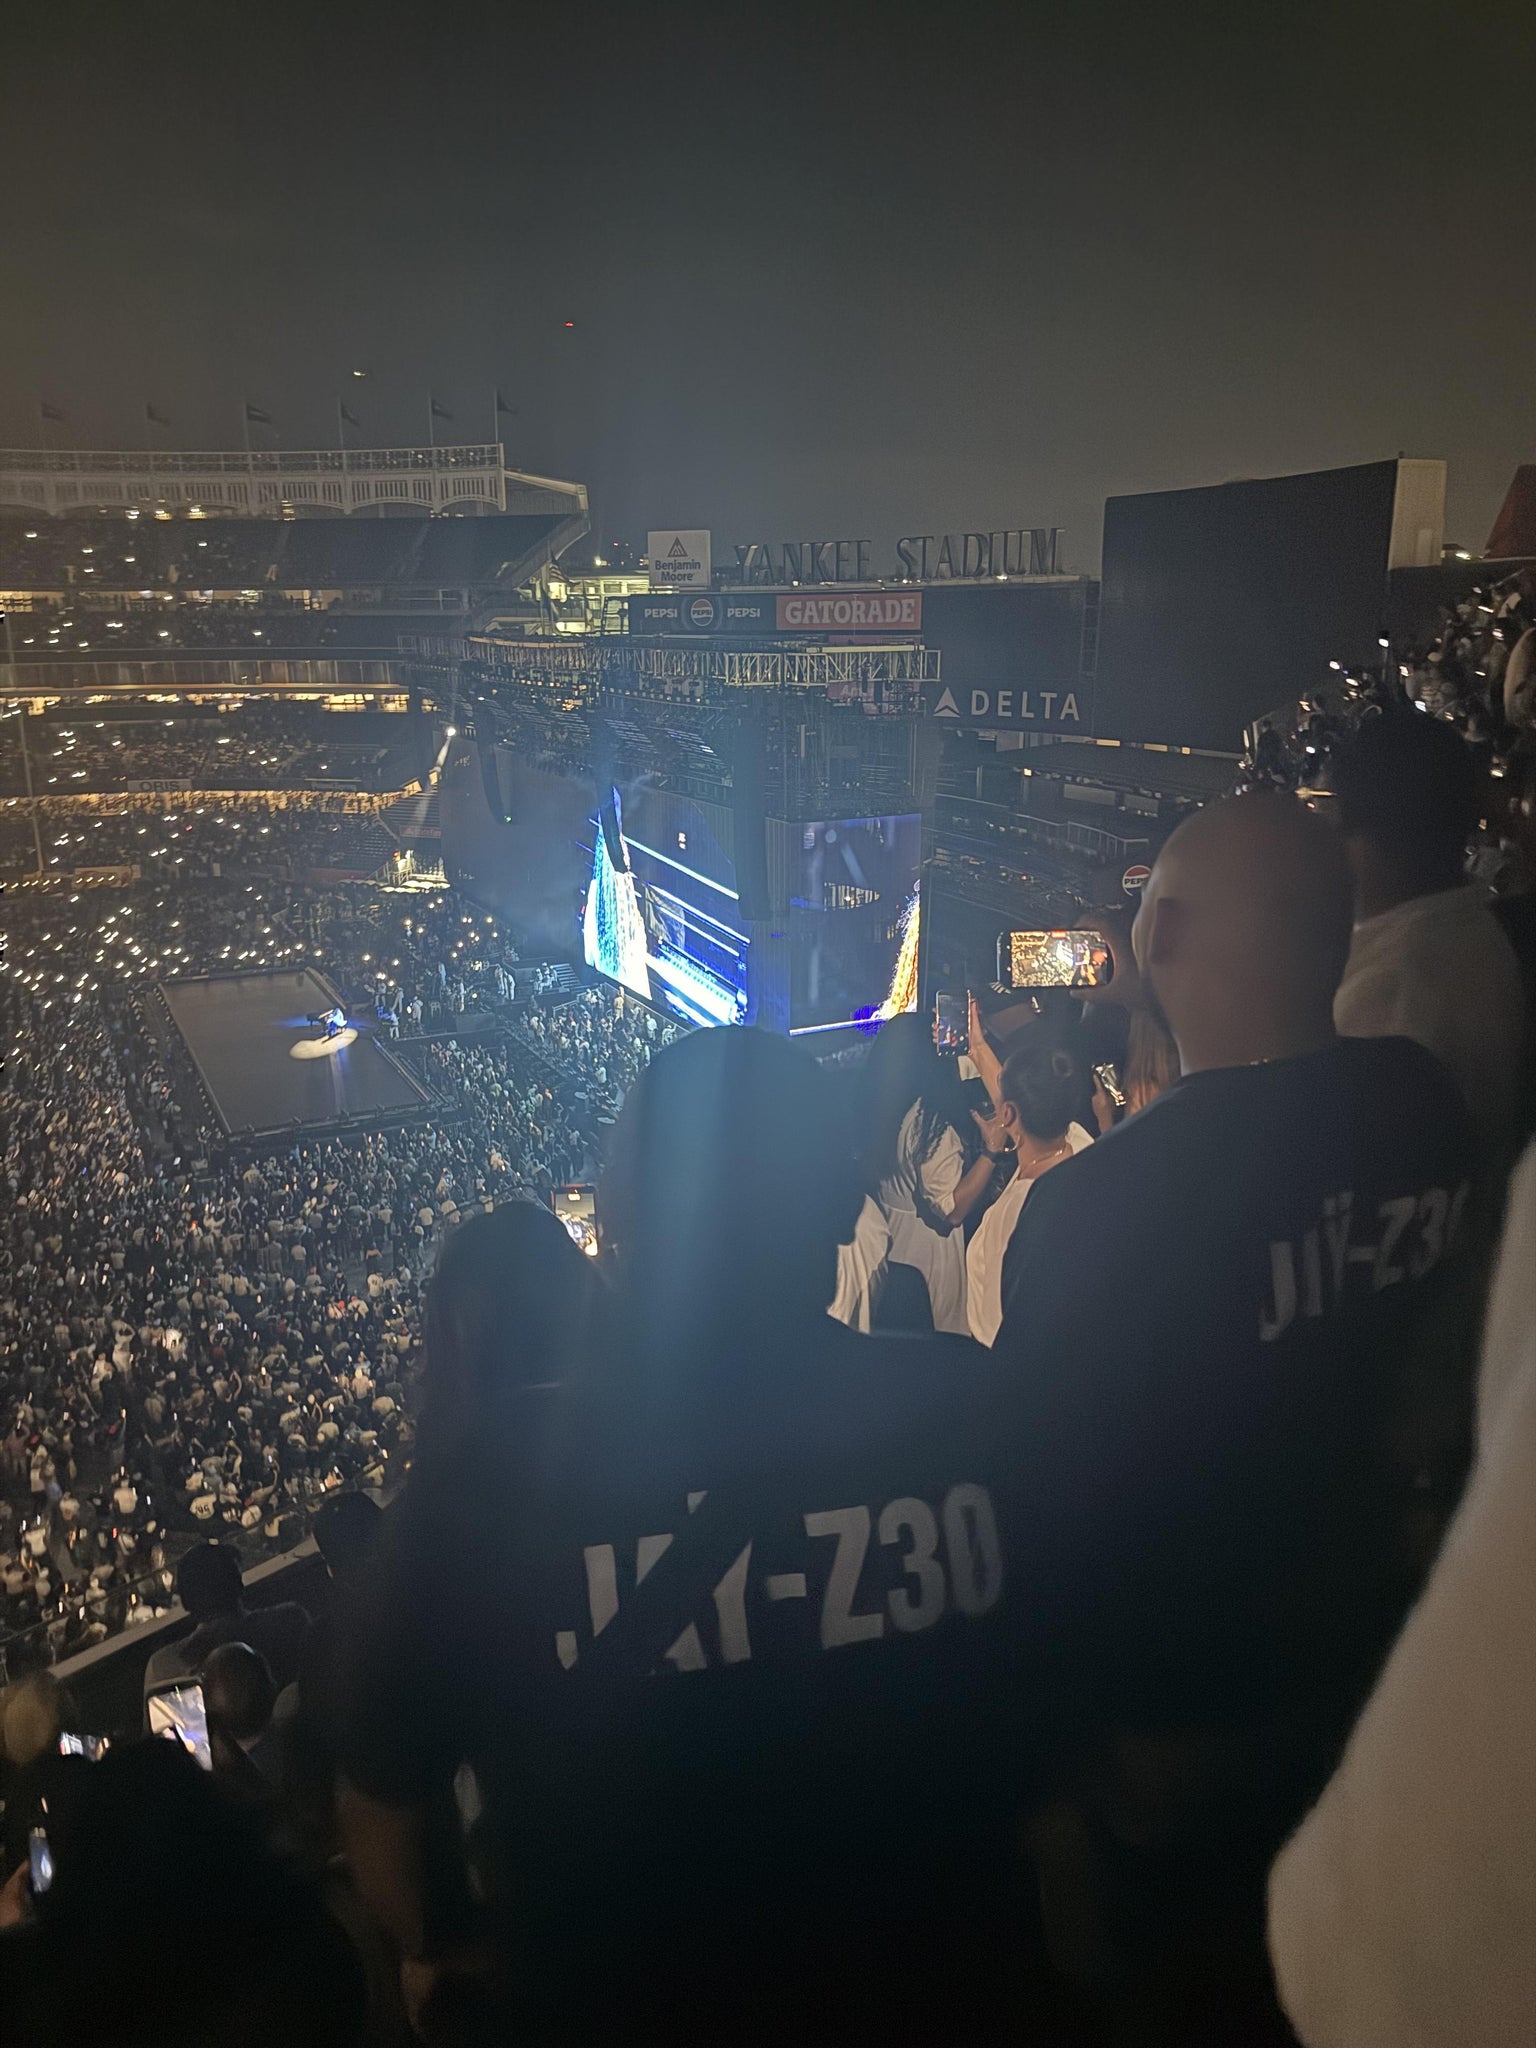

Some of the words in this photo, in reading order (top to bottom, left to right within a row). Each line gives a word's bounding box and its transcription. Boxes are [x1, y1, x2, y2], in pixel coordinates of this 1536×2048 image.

[734, 539, 872, 583] YANKEE
[896, 527, 1066, 580] STADIUM
[655, 559, 700, 572] Benjamin
[661, 571, 693, 582] Moore
[644, 608, 678, 618] PEPSI
[692, 608, 713, 617] PEPSI
[727, 608, 760, 618] PEPSI
[785, 599, 915, 625] GATORADE
[970, 689, 1081, 721] DELTA
[139, 780, 180, 792] ORIS
